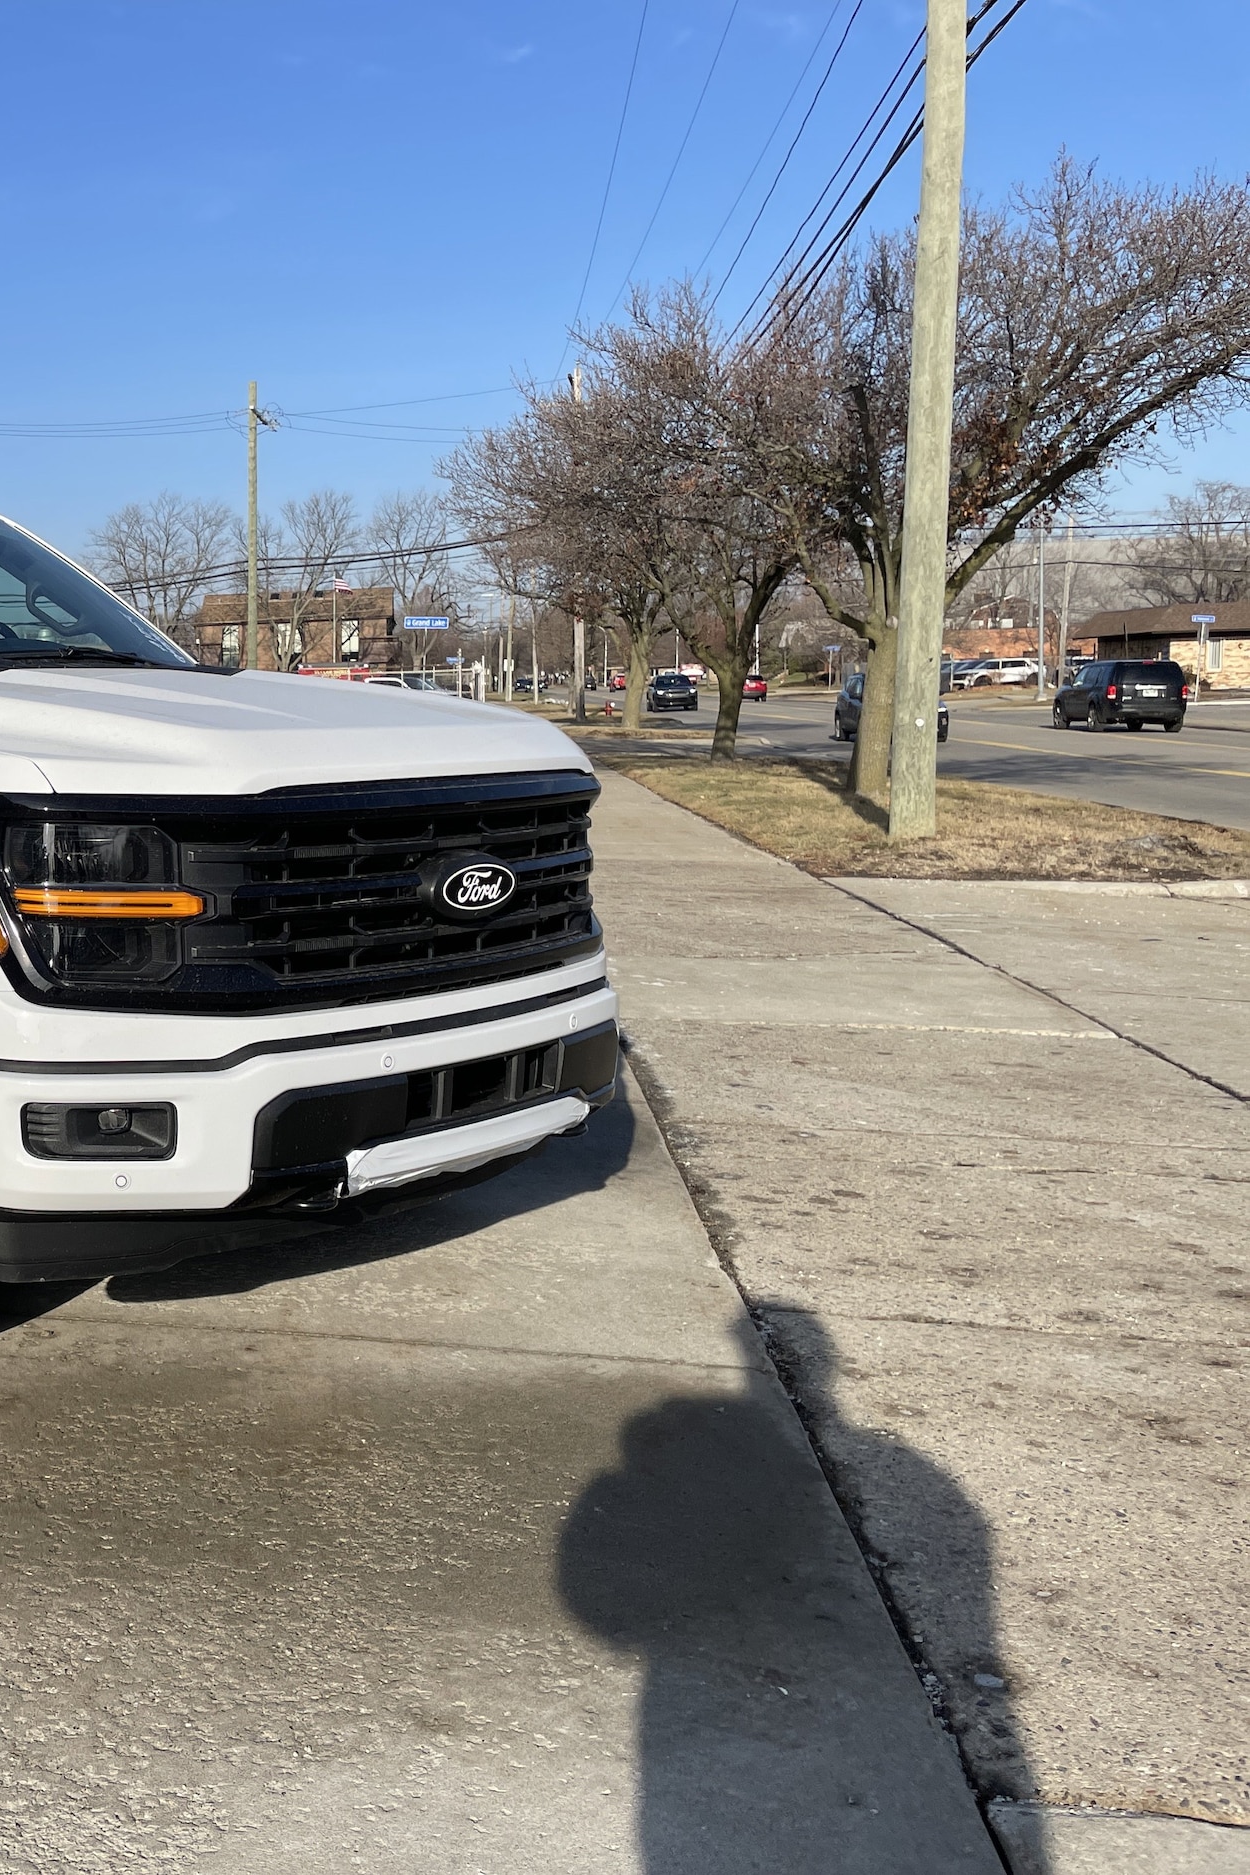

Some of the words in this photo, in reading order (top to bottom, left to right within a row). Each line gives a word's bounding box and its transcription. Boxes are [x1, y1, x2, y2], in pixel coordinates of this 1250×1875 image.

[412, 619, 430, 627] Grand
[432, 619, 446, 627] Lake
[457, 870, 503, 903] Ford
